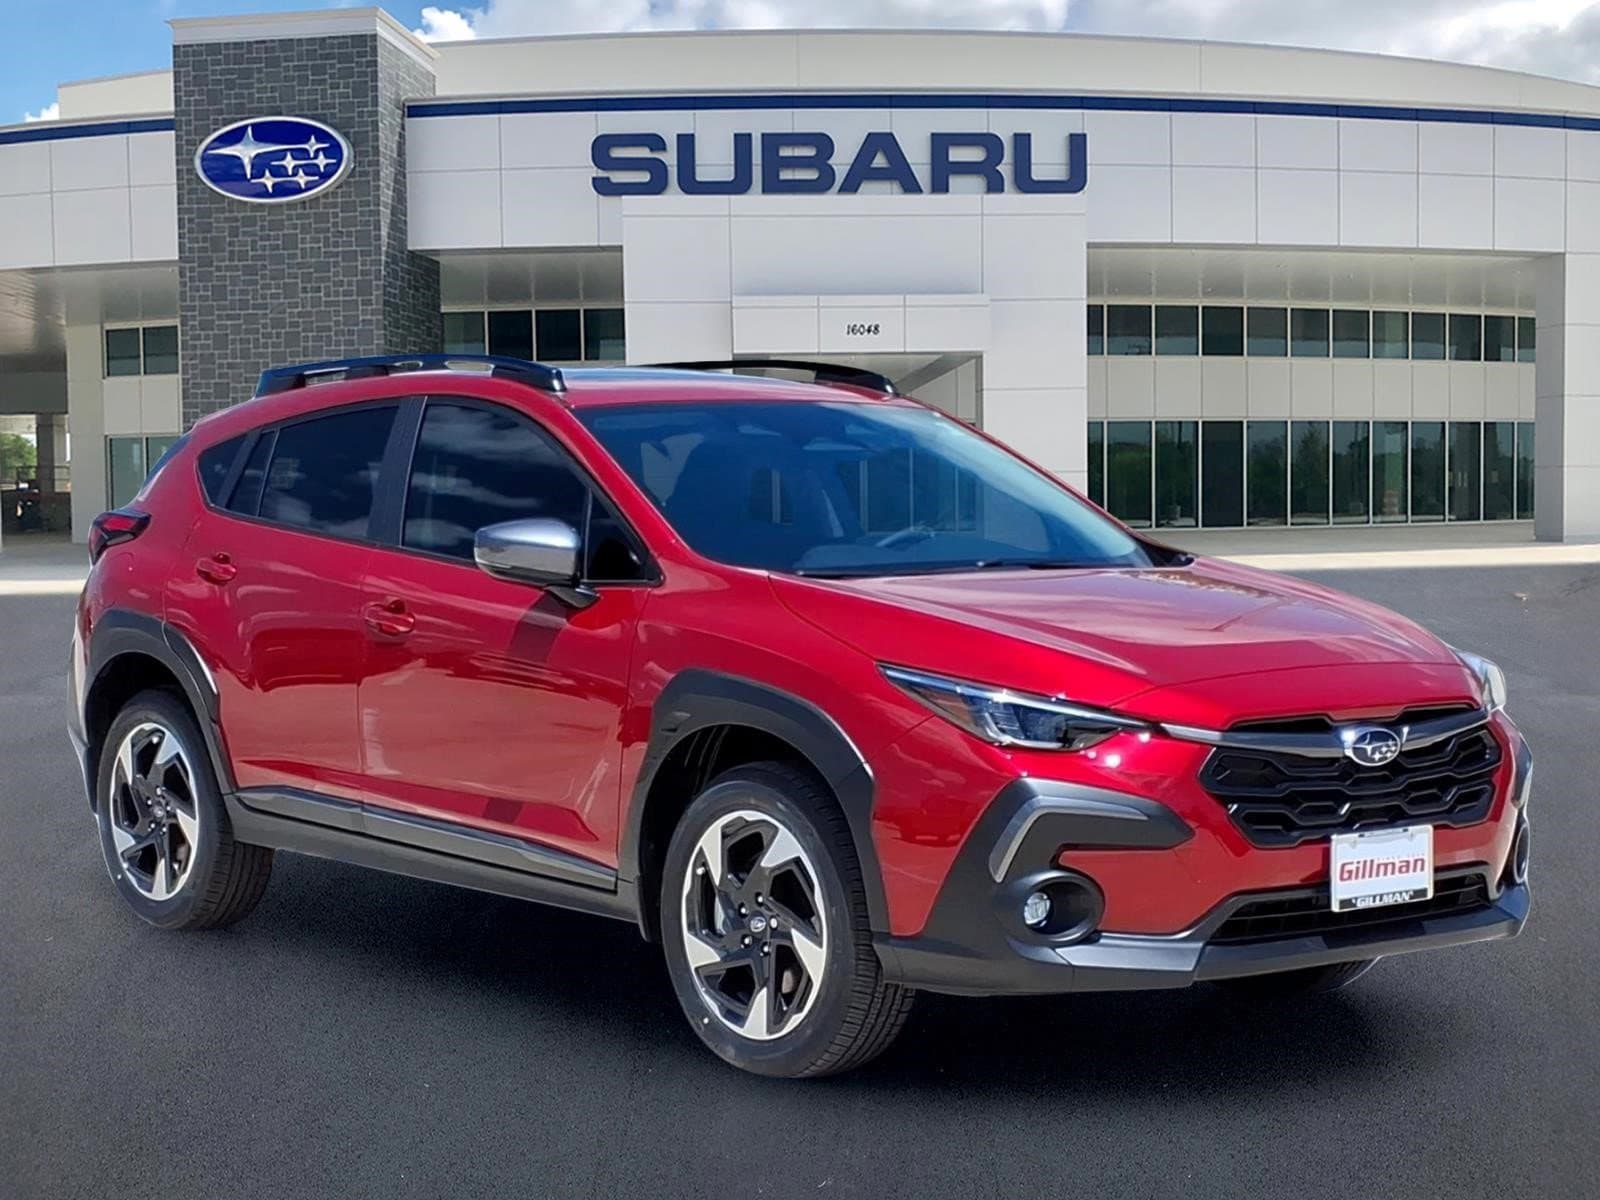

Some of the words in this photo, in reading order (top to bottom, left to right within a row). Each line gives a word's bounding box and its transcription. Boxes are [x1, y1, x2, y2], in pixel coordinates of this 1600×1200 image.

[591, 132, 1088, 196] SUBARU
[847, 324, 880, 336] 16048
[1339, 858, 1425, 882] Gillman
